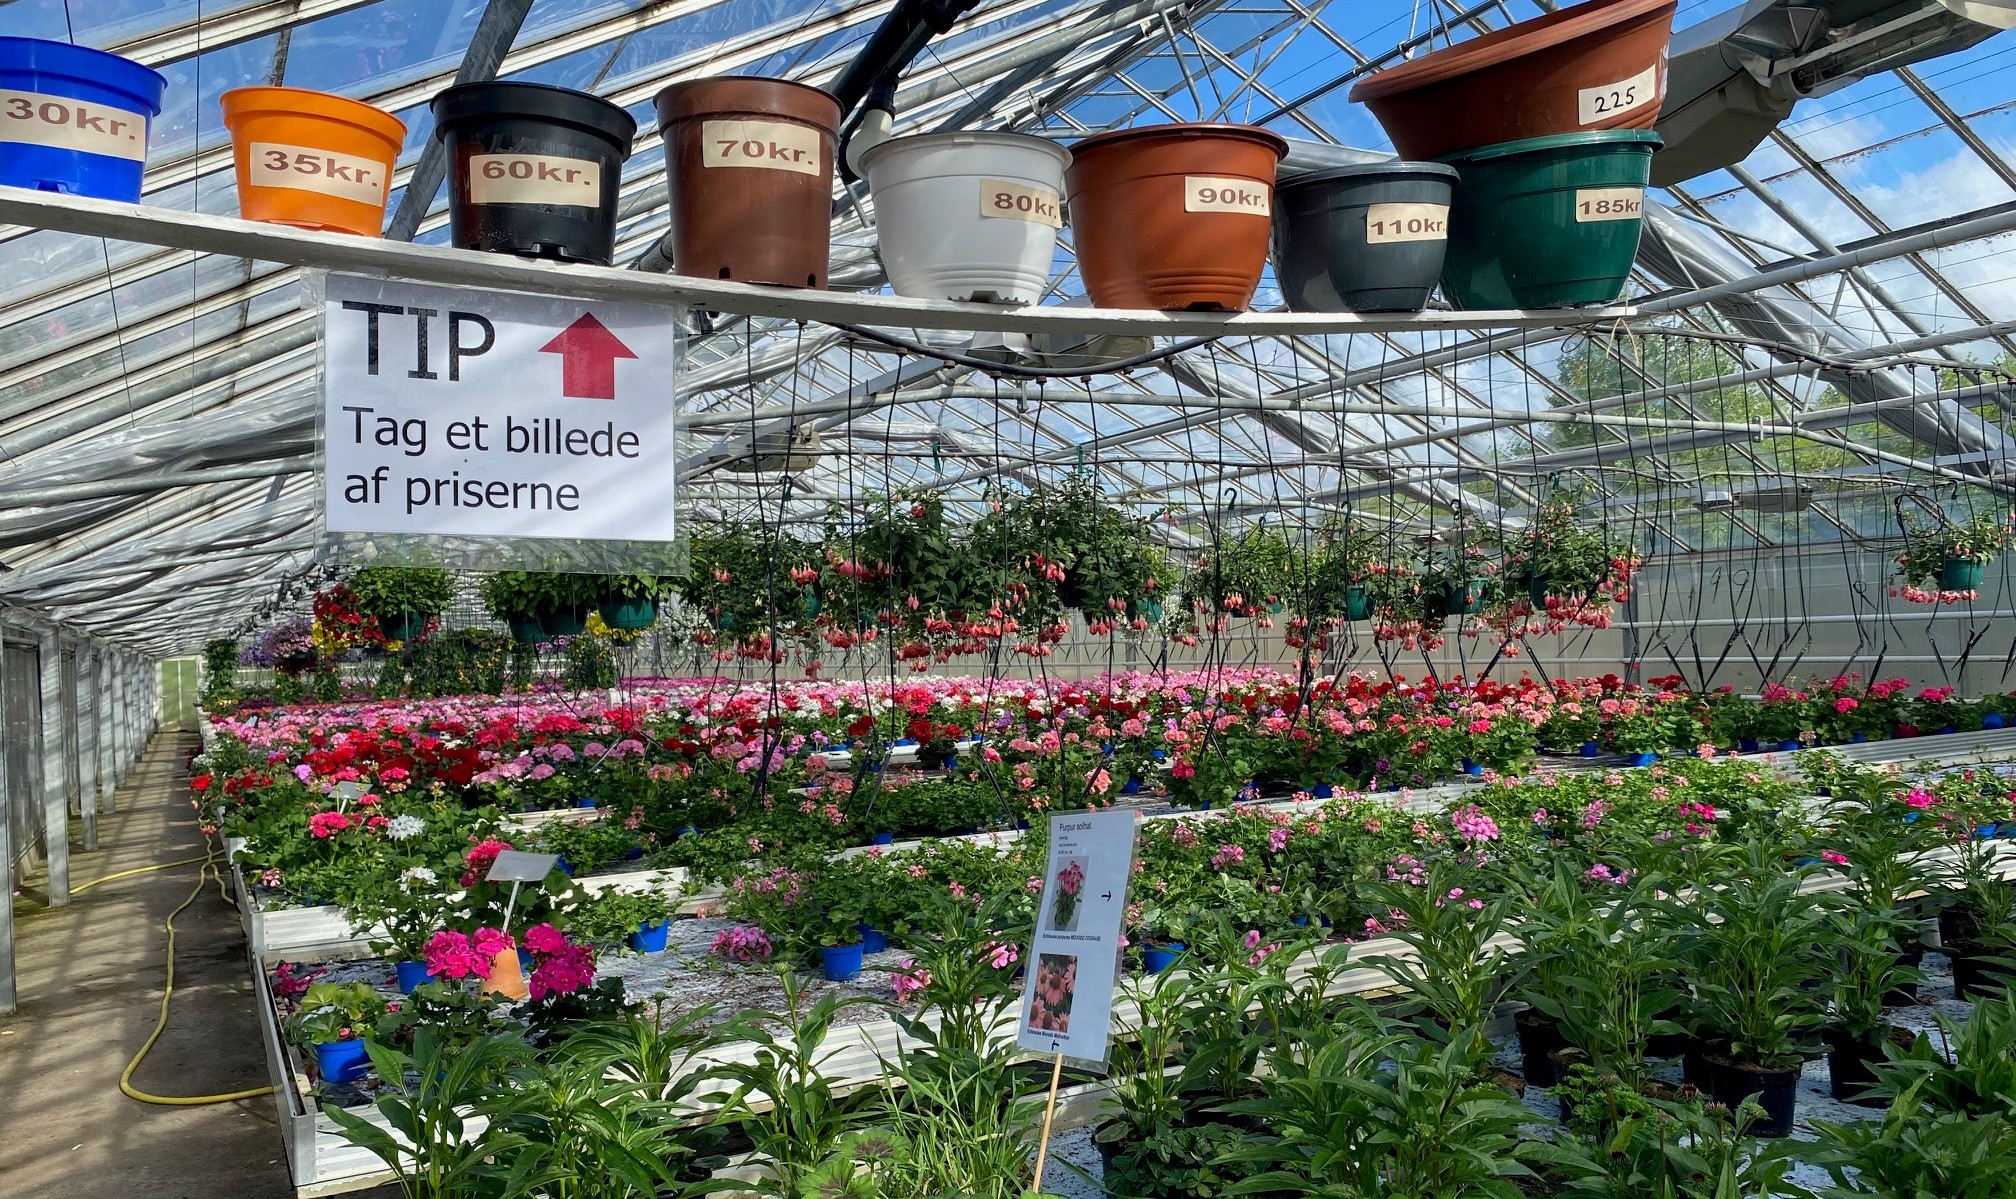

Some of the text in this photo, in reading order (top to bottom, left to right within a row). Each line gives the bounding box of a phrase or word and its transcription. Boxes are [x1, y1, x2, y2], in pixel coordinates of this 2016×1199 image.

[1594, 86, 1636, 115] 225
[6, 97, 136, 141] 30kr.
[716, 139, 814, 166] 70kr.
[264, 150, 379, 187] 35kr.
[481, 160, 591, 186] 60kr.
[994, 192, 1058, 220] 80kr.
[1197, 187, 1265, 208] 90kr.
[1578, 199, 1641, 215] 185kr
[1370, 218, 1446, 236] 110kr.
[341, 299, 496, 382] TIP
[342, 406, 640, 459] Tag et billede
[344, 466, 580, 515] af priserne
